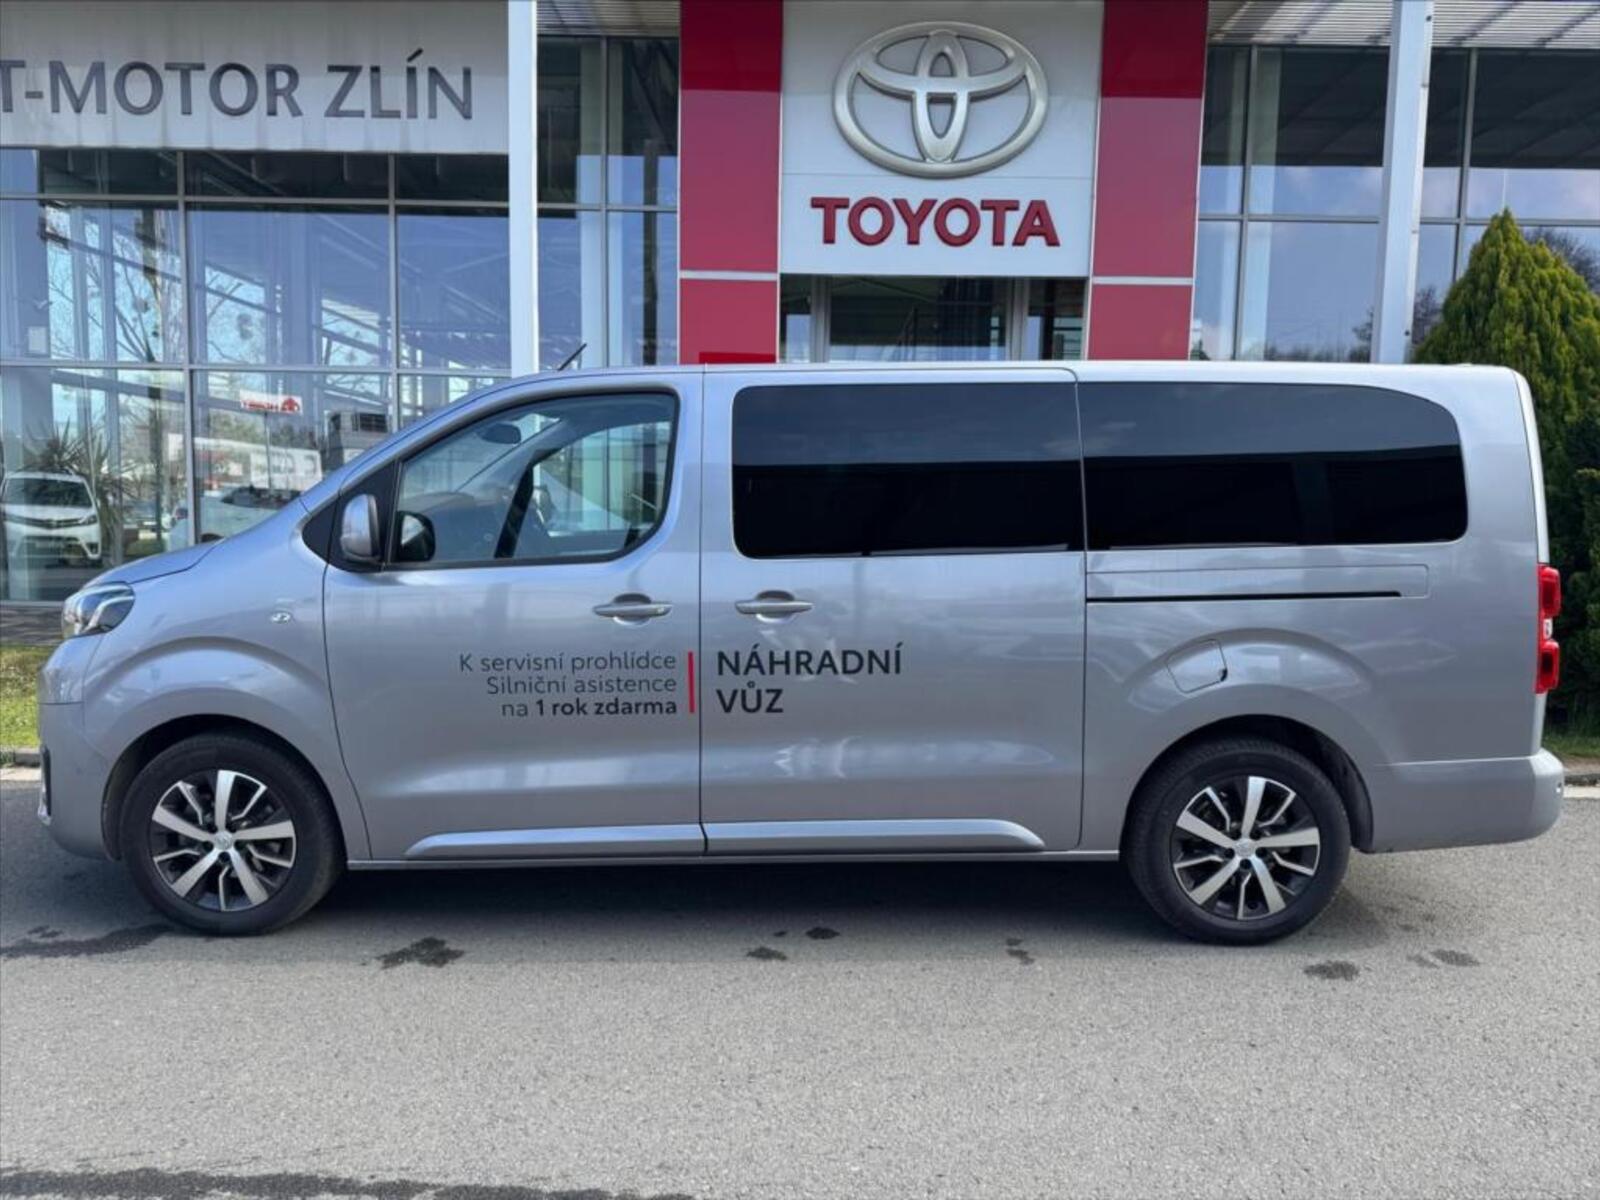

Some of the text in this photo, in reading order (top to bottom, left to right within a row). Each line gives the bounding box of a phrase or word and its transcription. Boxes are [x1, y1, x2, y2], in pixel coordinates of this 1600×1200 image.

[324, 48, 473, 120] ZLÍN
[810, 196, 1060, 247] TOYOTA
[459, 651, 677, 674] K servisní prohlídce
[717, 642, 903, 676] NÁHRADNÍ
[486, 675, 677, 695] Silniční asistence
[716, 680, 784, 713] VŮZ
[501, 698, 678, 717] na 1 rok zdarma
